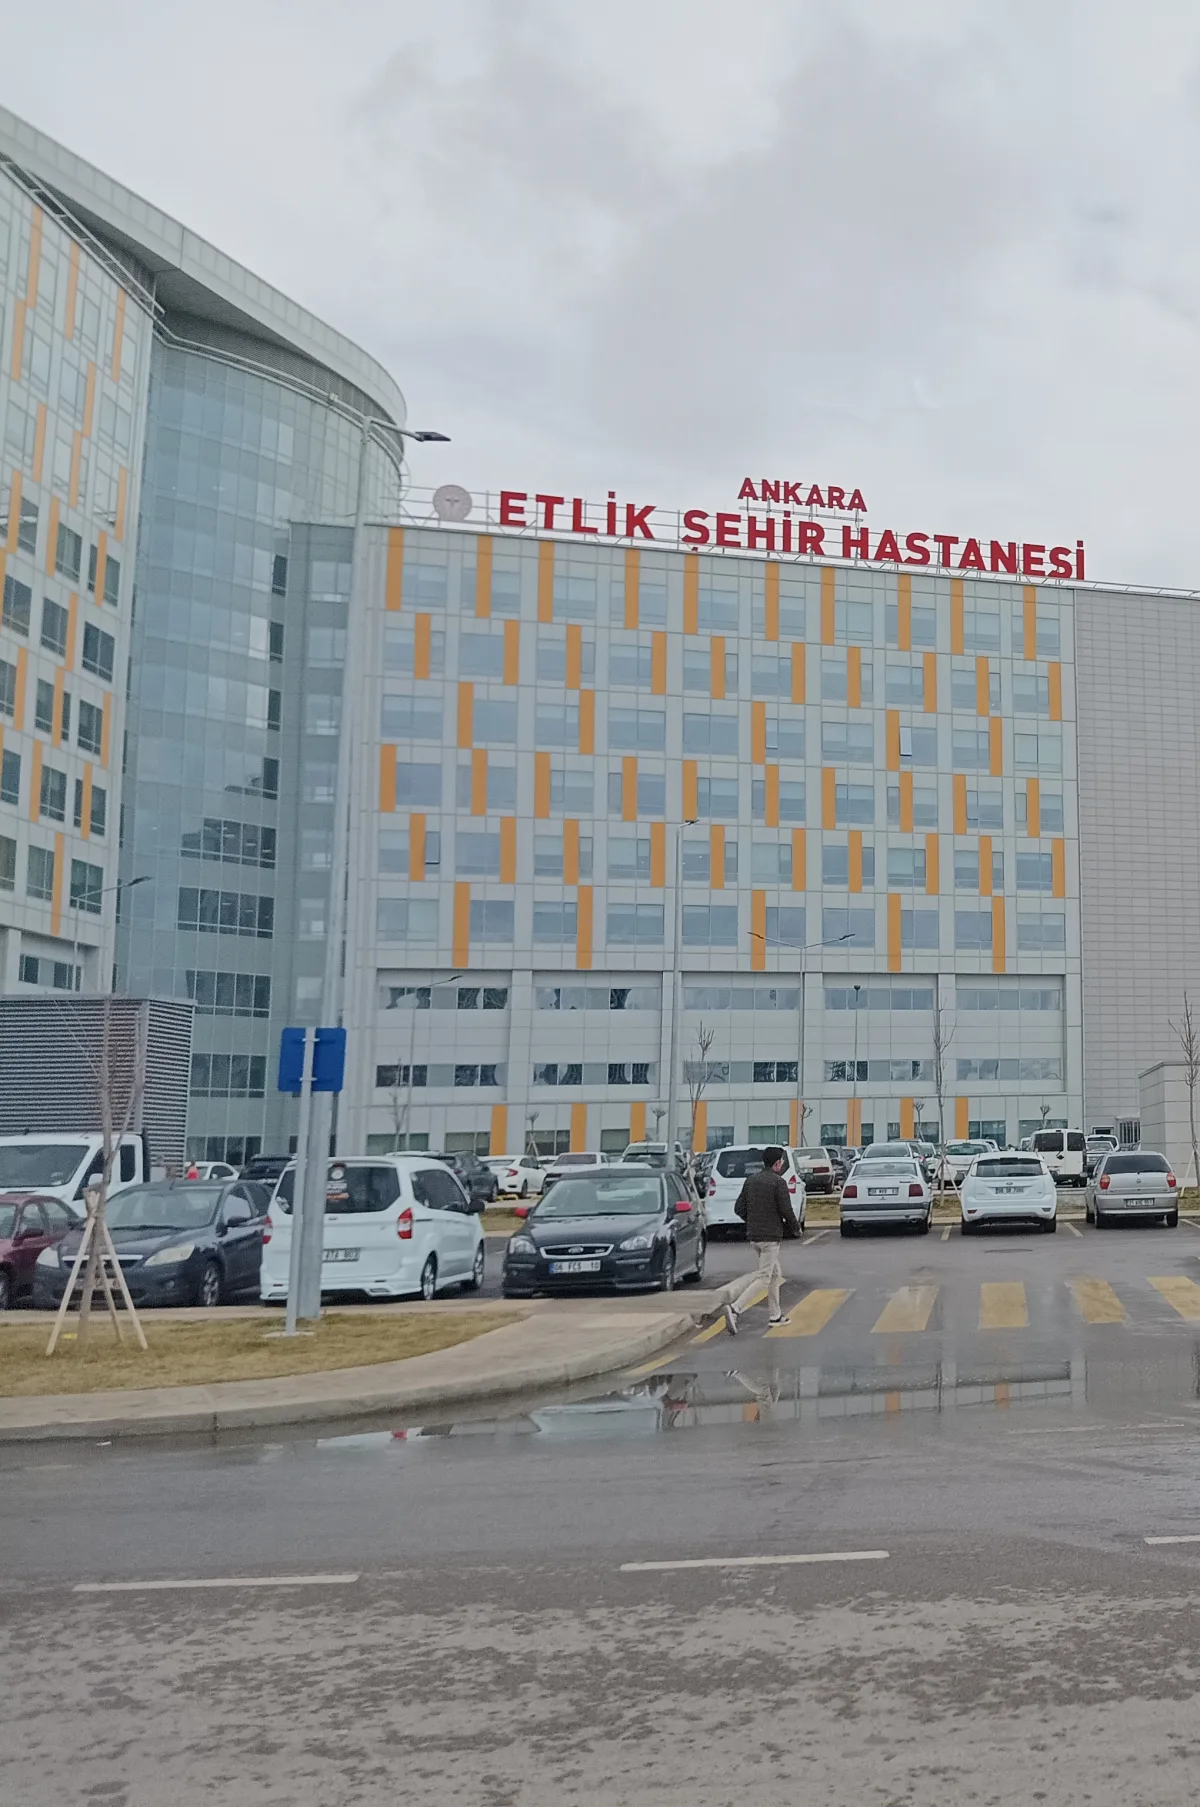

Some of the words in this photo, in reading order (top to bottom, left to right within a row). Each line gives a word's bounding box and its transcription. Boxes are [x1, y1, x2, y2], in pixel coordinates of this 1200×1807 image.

[737, 477, 868, 513] ANKARA
[500, 491, 657, 540] ETLİK
[682, 509, 826, 556] ŞEHİR
[842, 524, 1085, 581] HASTANESİ
